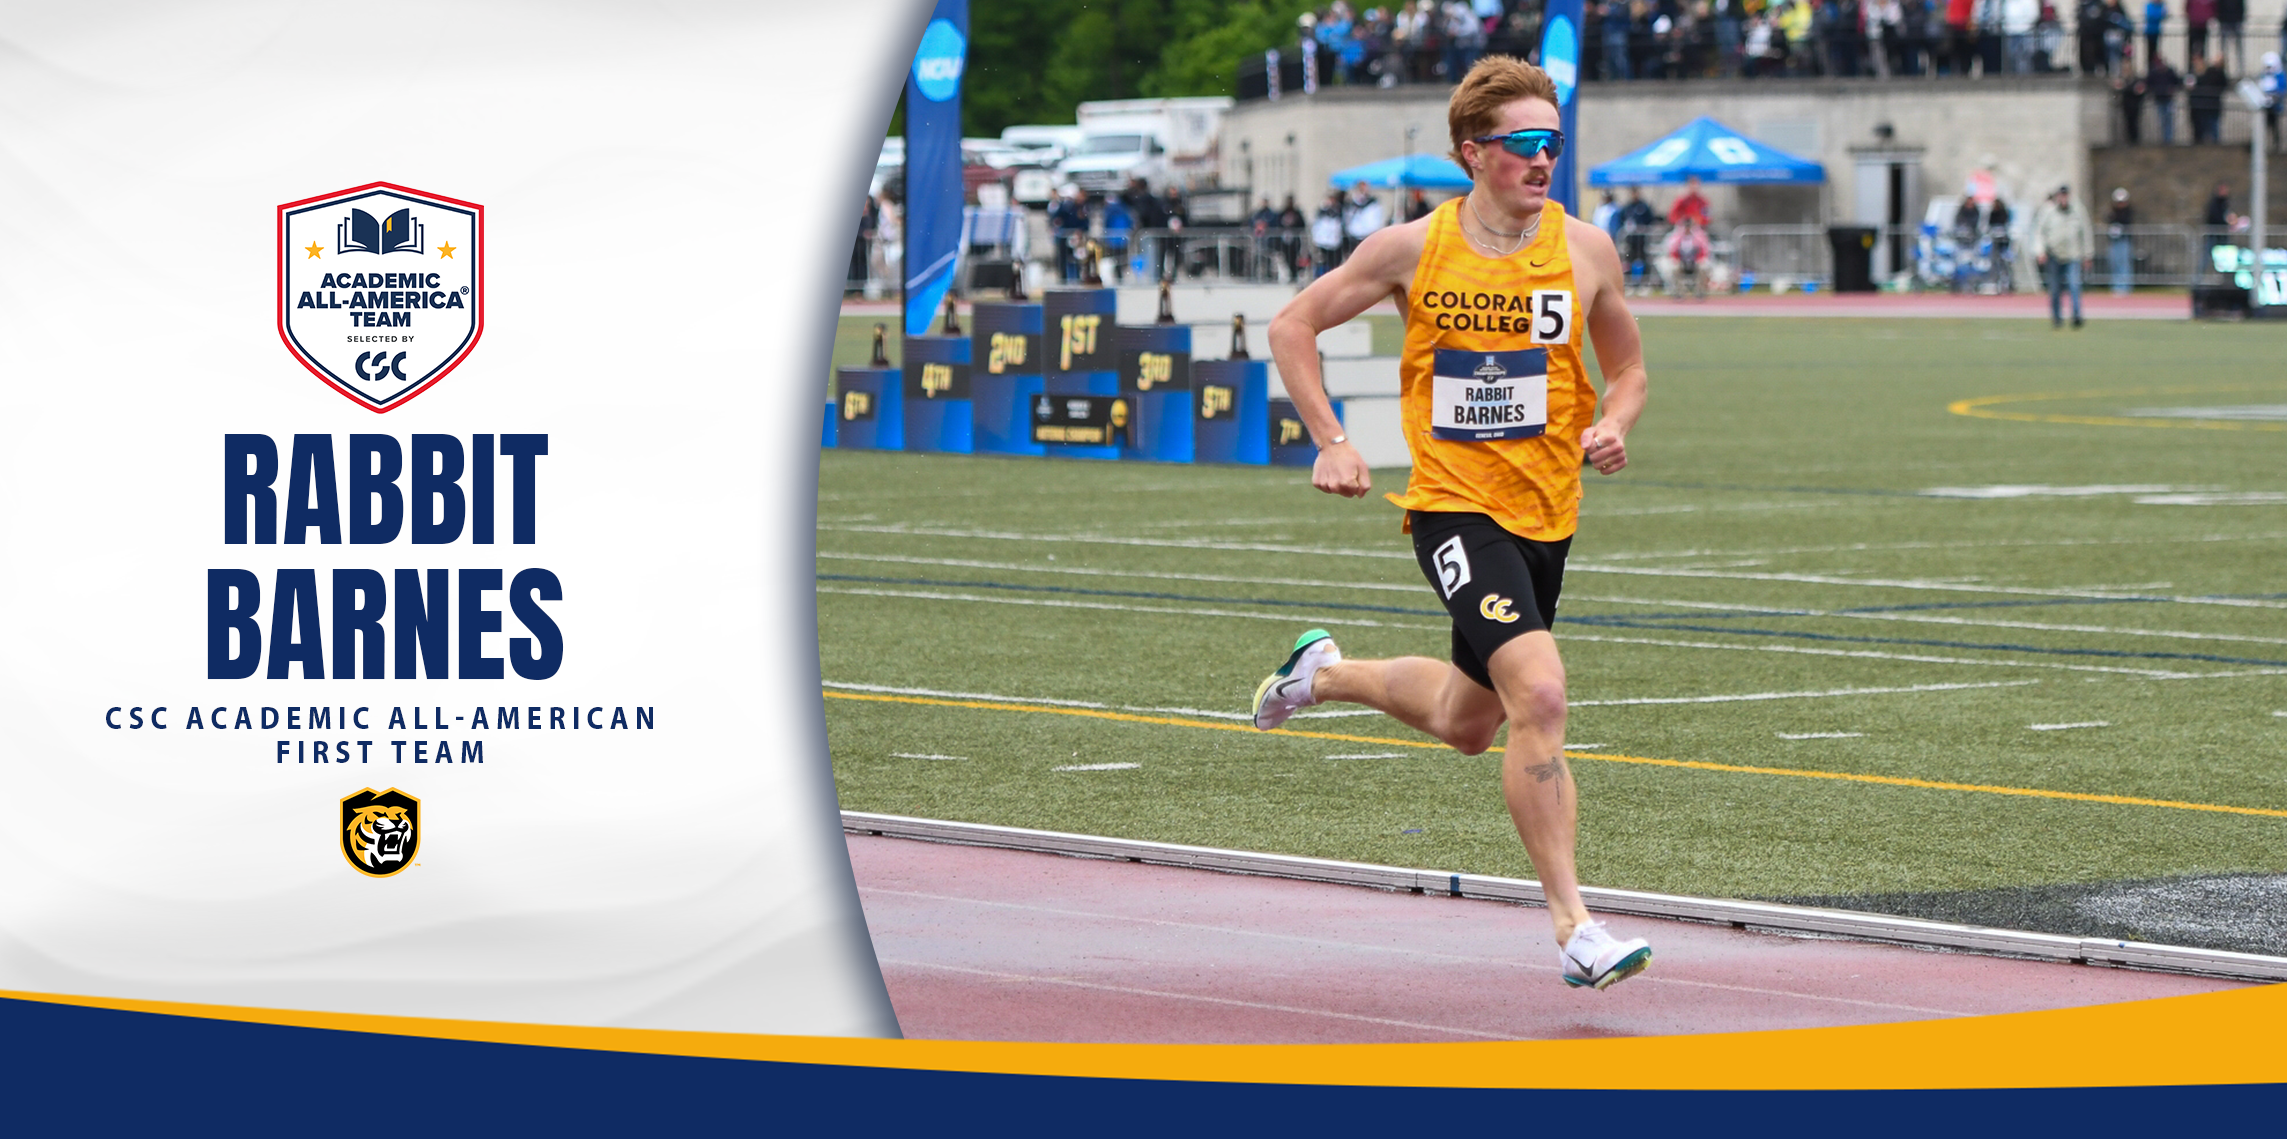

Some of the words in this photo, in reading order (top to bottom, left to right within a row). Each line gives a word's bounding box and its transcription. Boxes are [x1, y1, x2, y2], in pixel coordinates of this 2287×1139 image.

[1423, 291, 1533, 314] COLORAD
[1538, 294, 1564, 340] 5
[1436, 313, 1530, 334] COLLEG
[988, 332, 1027, 374] 2ND
[1060, 314, 1101, 371] 1ST
[921, 362, 953, 398] 4TH
[1136, 351, 1173, 391] 3RD
[844, 391, 870, 420] 6TH
[1202, 385, 1233, 418] 5TH
[1465, 386, 1515, 402] RABBIT
[1454, 403, 1526, 425] BARNES
[1279, 418, 1302, 445] 7TH
[1437, 543, 1461, 593] 5
